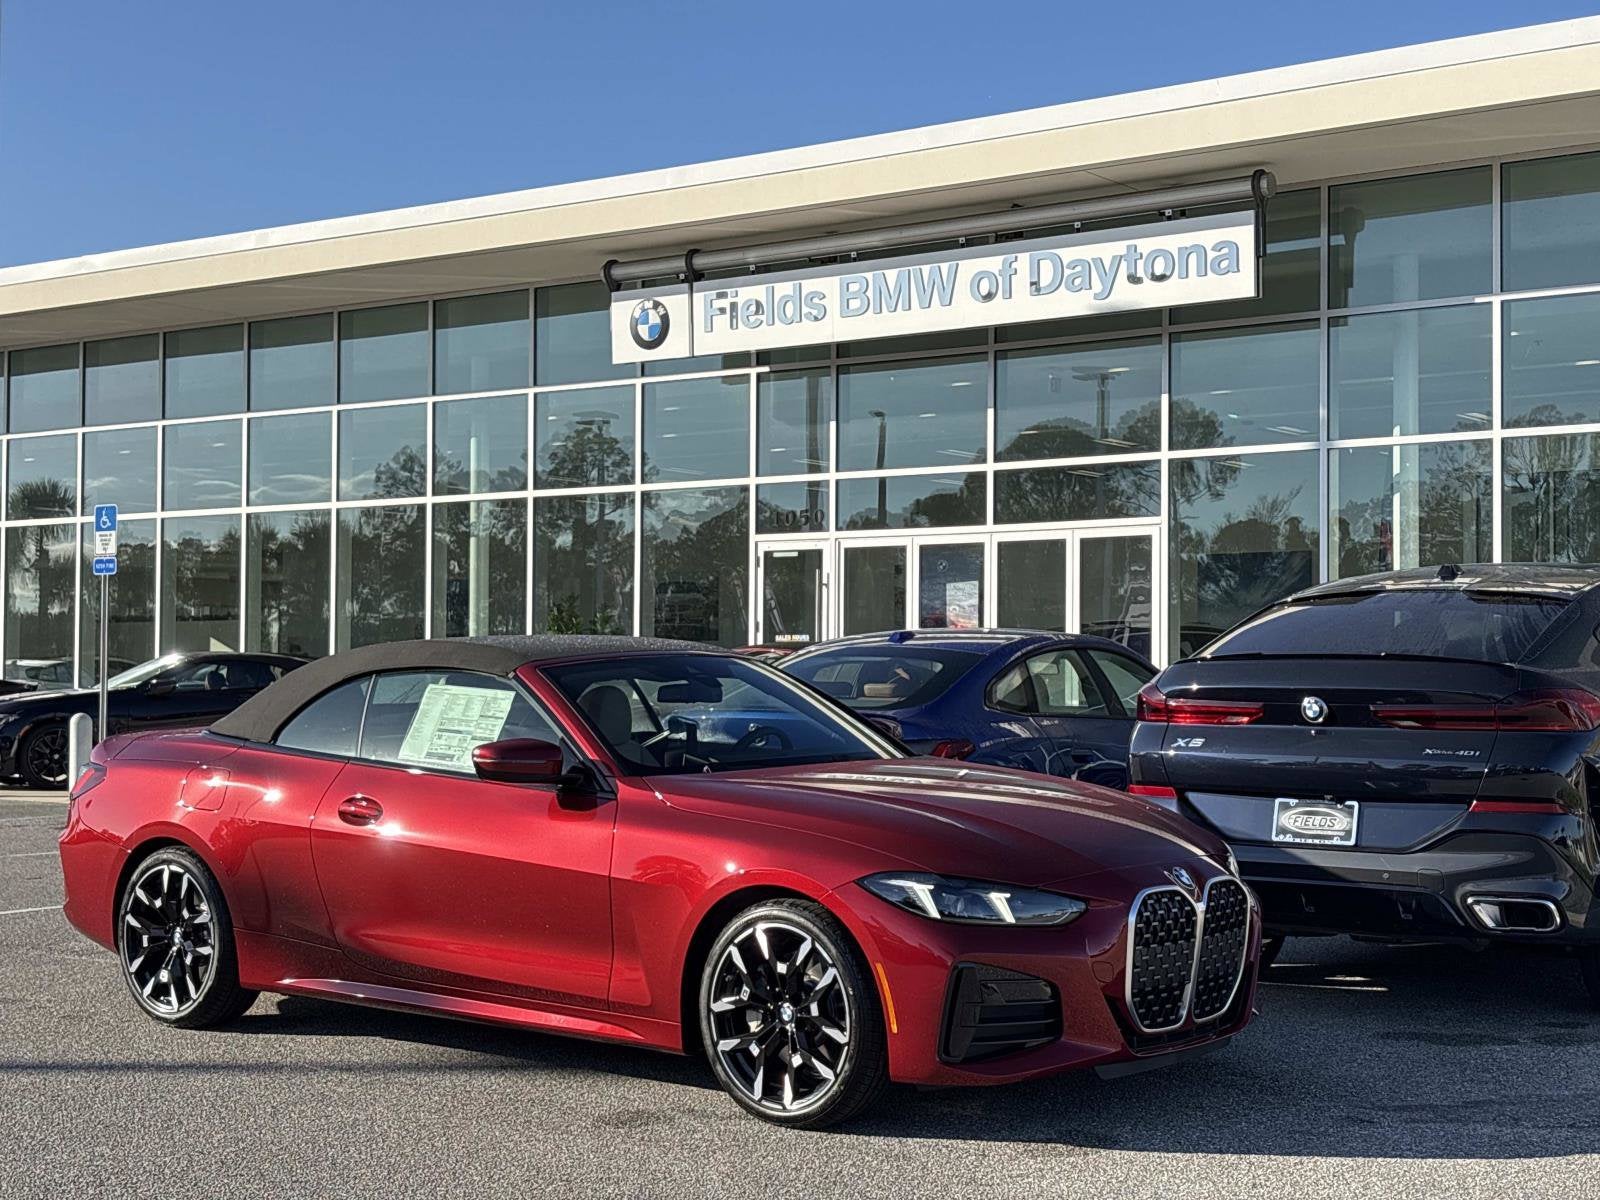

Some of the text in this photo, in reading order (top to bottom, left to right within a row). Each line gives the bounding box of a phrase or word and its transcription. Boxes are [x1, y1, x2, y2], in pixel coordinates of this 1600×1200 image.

[703, 240, 1241, 333] Fields BMW of Daytona
[773, 509, 825, 527] 1050
[1292, 816, 1337, 828] FIELDS
